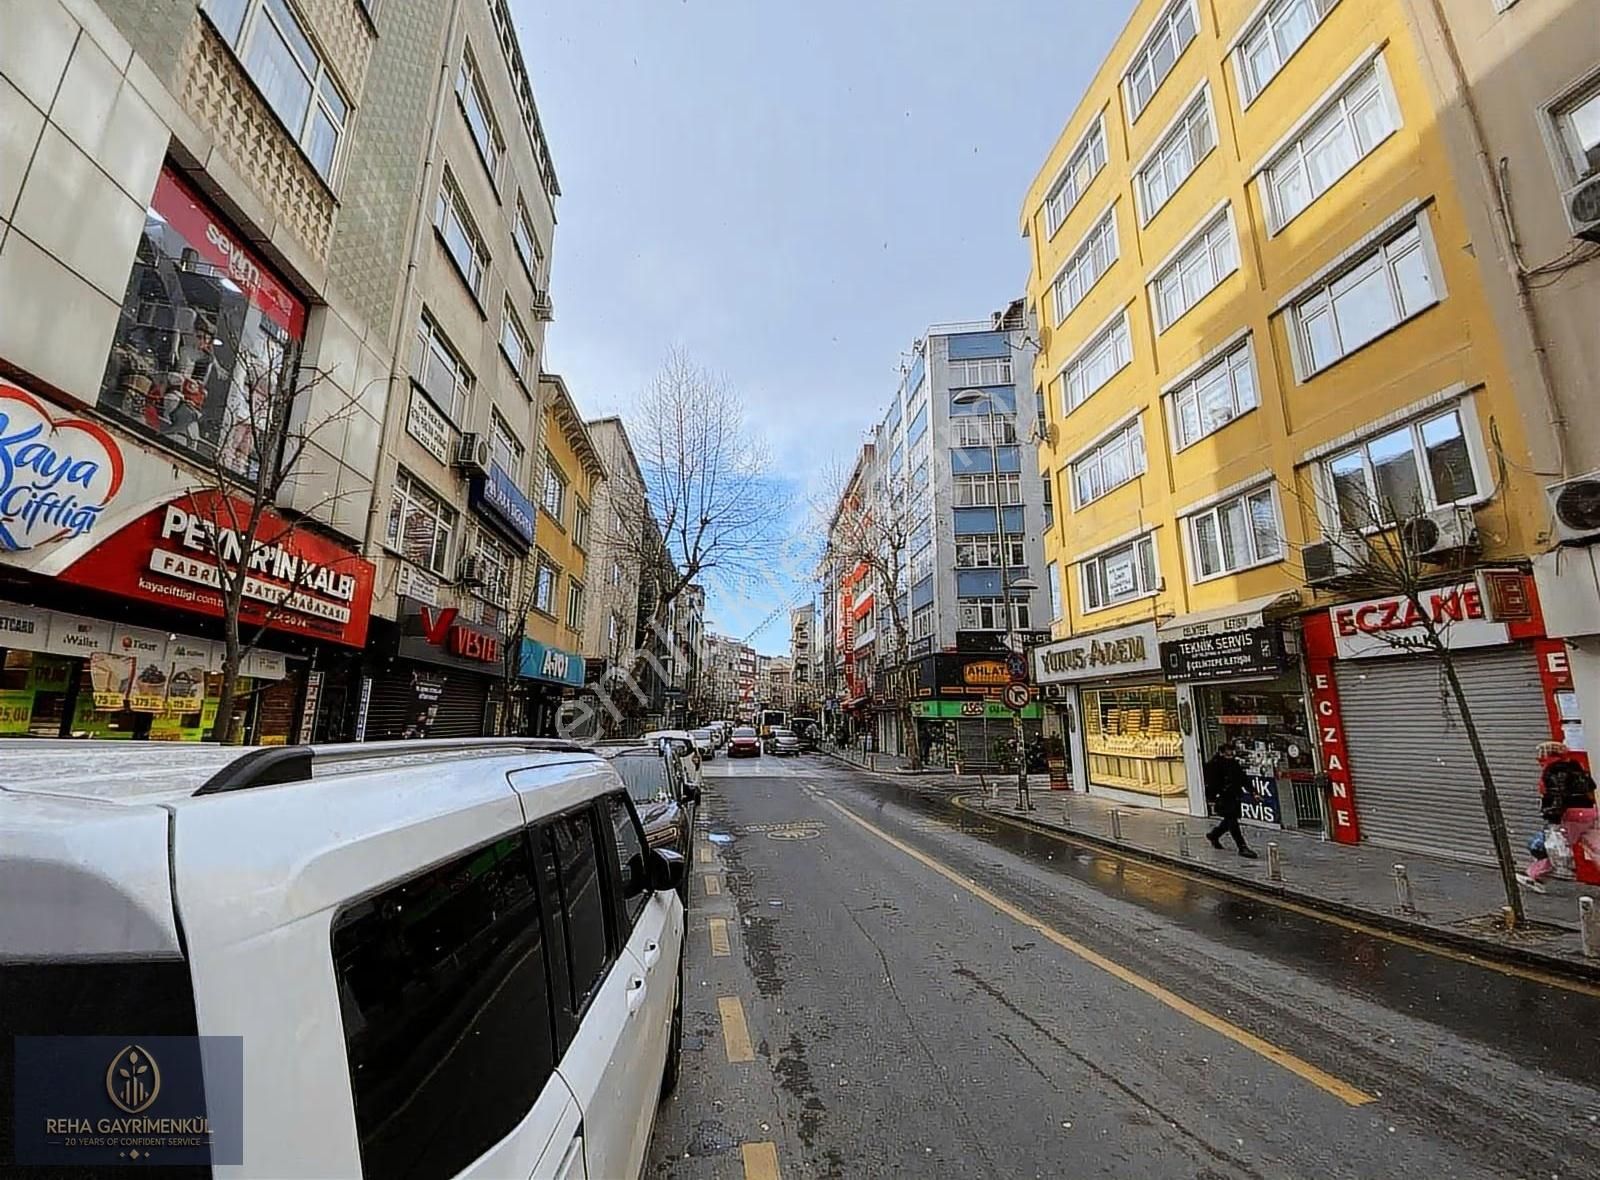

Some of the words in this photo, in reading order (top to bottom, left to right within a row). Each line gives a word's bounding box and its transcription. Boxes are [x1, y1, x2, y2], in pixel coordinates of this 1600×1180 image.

[1336, 588, 1484, 637] ECZANE
[1179, 638, 1215, 655] TEKNİK
[1215, 631, 1254, 650] SERVİS
[1315, 674, 1350, 828] ECZANE
[1240, 802, 1274, 822] RVİS
